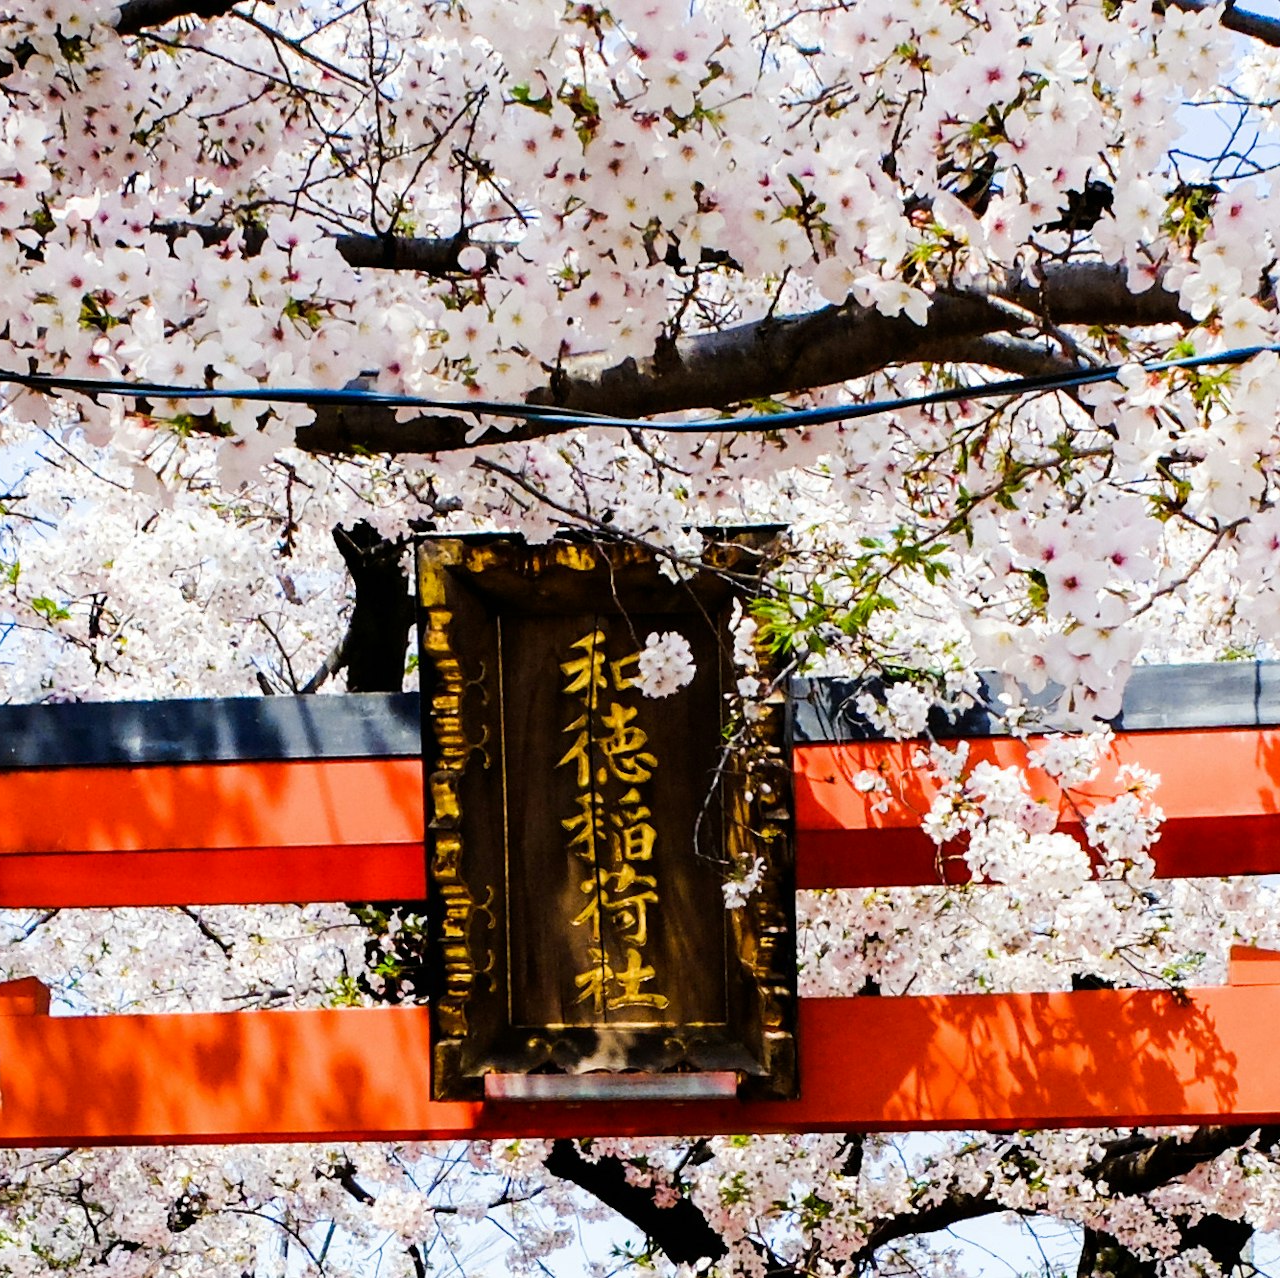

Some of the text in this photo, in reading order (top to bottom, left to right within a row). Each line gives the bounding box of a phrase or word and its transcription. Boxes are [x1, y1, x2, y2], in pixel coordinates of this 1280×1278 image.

[555, 629, 670, 1012] 和徳稲荷社
